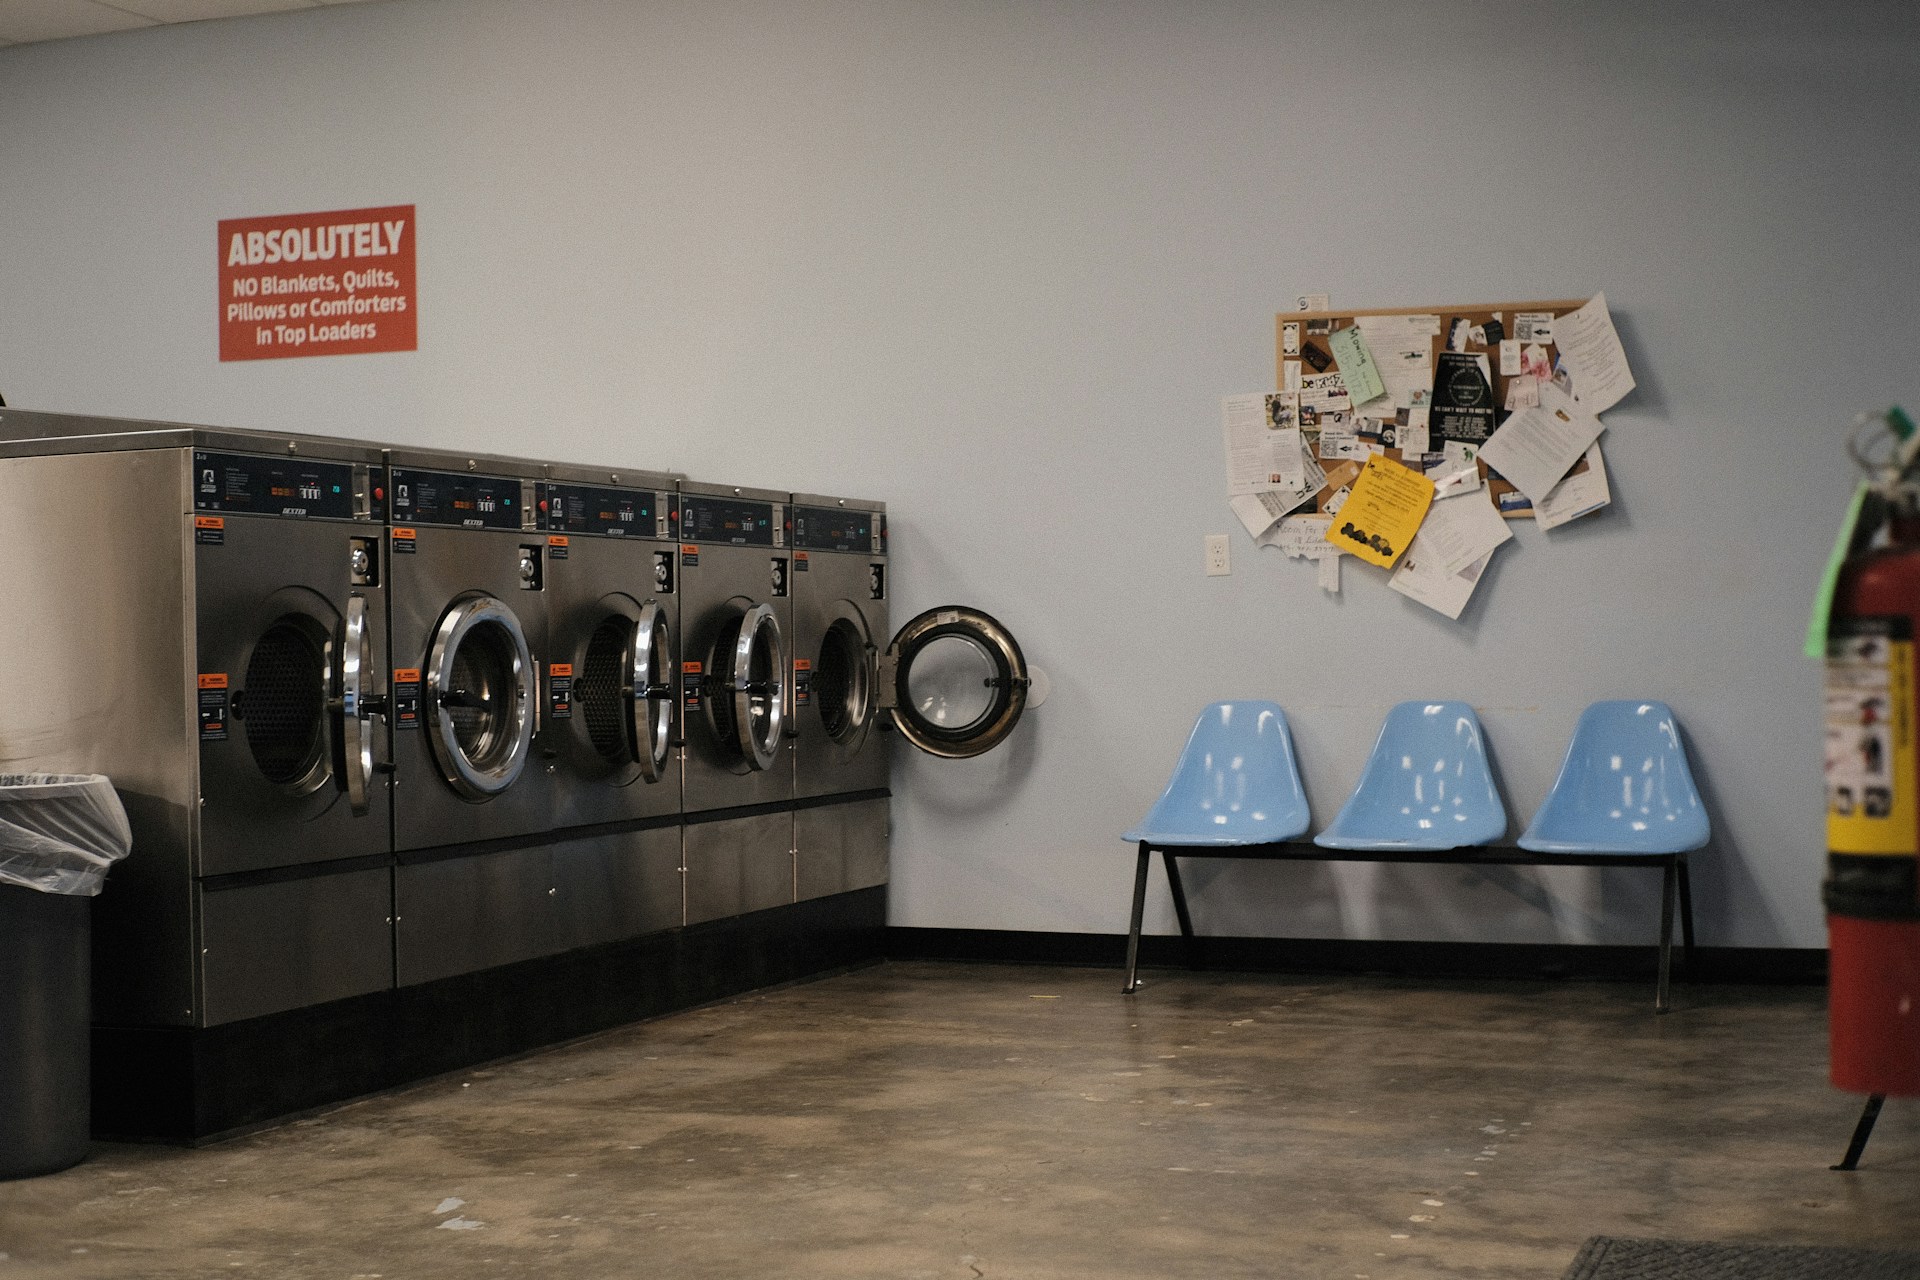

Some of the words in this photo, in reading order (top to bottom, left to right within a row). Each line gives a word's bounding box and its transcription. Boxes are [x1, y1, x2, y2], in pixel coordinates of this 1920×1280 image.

[227, 220, 405, 267] ABSOLUTELY
[233, 278, 258, 297] NO
[261, 273, 340, 296] Blankets,
[343, 268, 399, 293] Quilts,
[227, 302, 287, 322] Pillows
[289, 303, 307, 319] or
[310, 295, 407, 317] Comforters
[274, 325, 306, 346] Top
[309, 321, 376, 342] Loaders
[1348, 327, 1367, 367] Mowing
[1302, 376, 1314, 389] be
[283, 507, 307, 515] DEXTER
